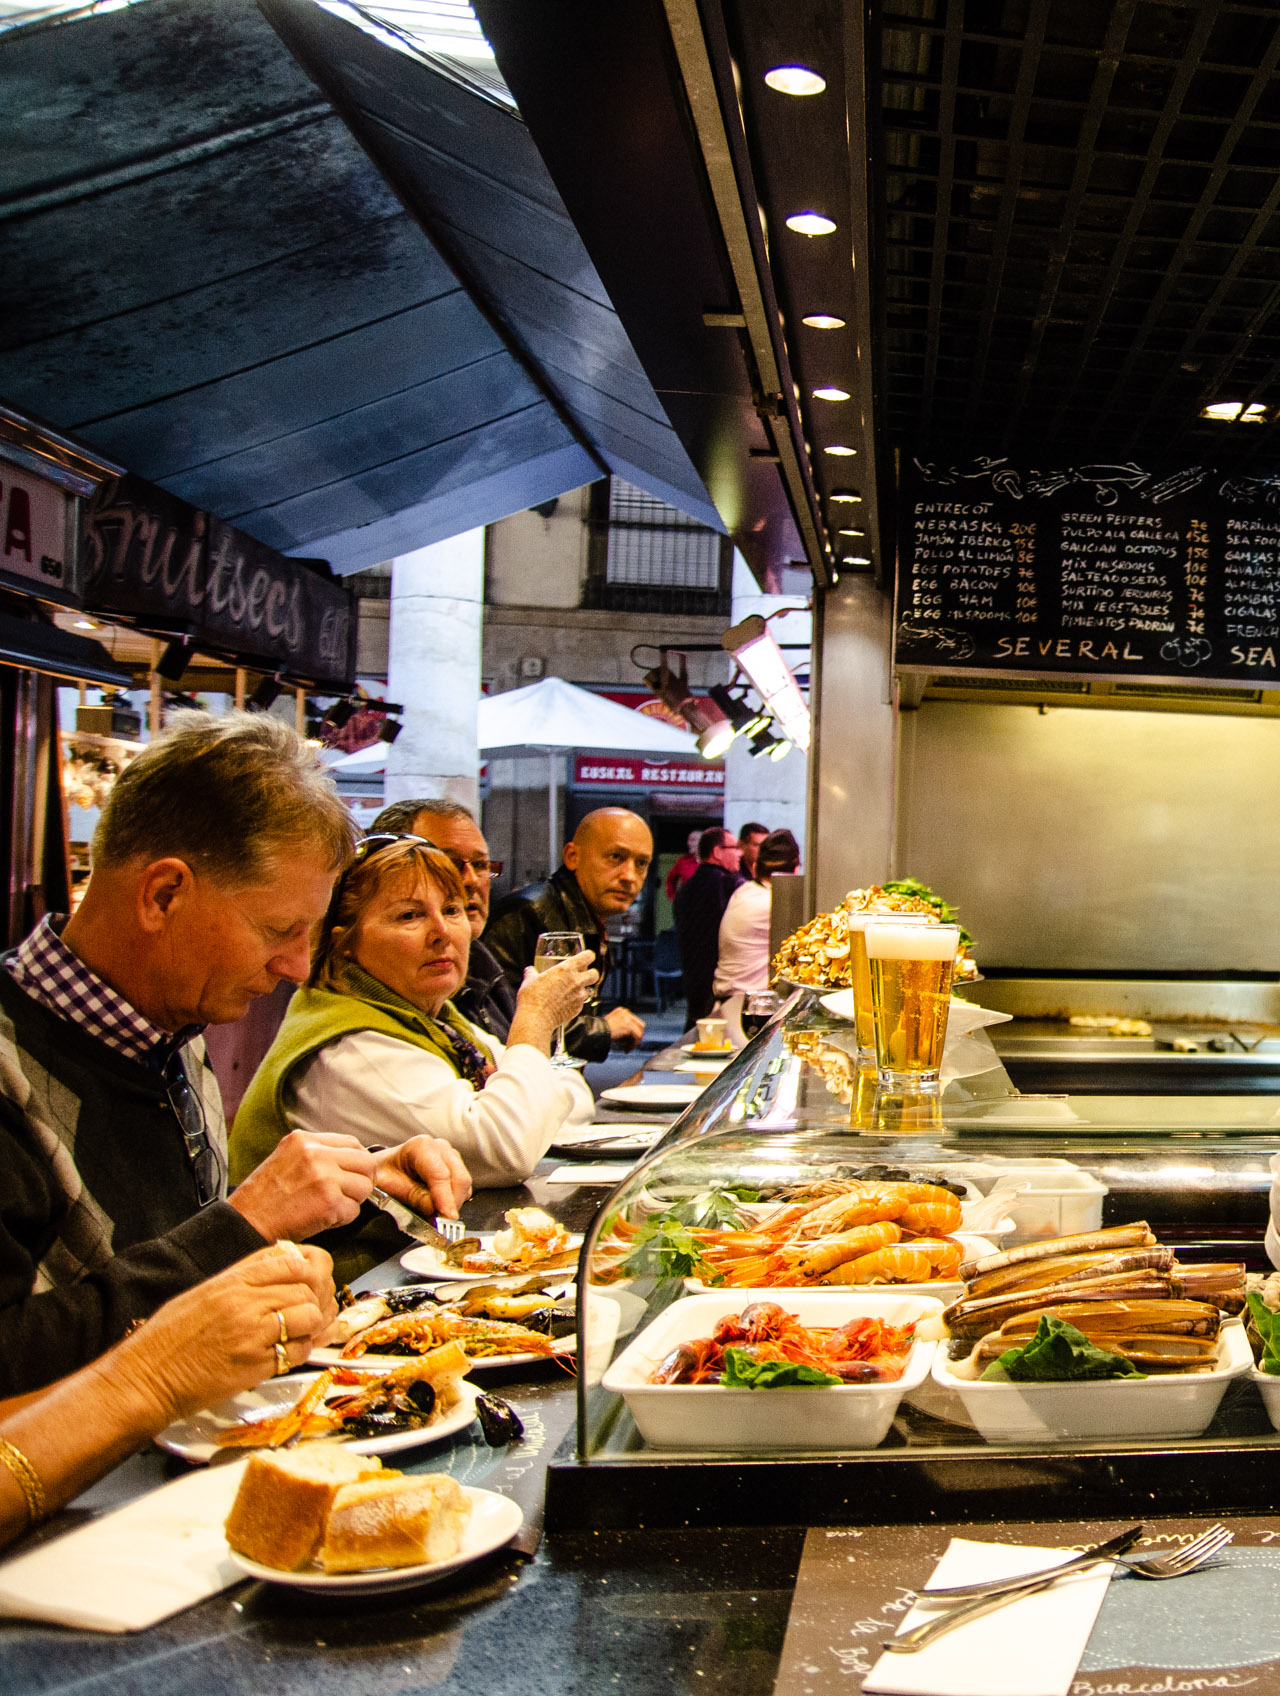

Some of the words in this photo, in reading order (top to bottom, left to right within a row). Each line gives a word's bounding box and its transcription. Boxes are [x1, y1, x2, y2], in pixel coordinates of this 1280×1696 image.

[914, 502, 994, 515] ENTRECOT
[0, 480, 32, 562] A
[914, 520, 1002, 534] NEBRASKA
[1008, 523, 1037, 536] 20€
[1061, 513, 1102, 523] GREEN
[1106, 513, 1162, 528] PEPPERS
[1061, 526, 1102, 538] PULPO
[1185, 530, 1210, 543] 15€
[1226, 534, 1250, 545] SEA
[1014, 538, 1036, 549] 15€
[1060, 541, 1117, 554] GALICIAN
[1124, 545, 1178, 559] OCTOPUS
[1186, 546, 1209, 559] 15€
[914, 548, 954, 559] POLLO
[1017, 550, 1036, 563] 8€
[912, 563, 938, 575] EGG
[942, 564, 1012, 579] POTATOES
[1062, 557, 1087, 570] MIX
[1184, 560, 1208, 573] 10€
[912, 578, 938, 590] EGG
[950, 578, 999, 590] BACON
[1016, 582, 1037, 593] 10€
[1130, 575, 1167, 587] SETAS
[1184, 574, 1208, 586] 10€
[912, 593, 942, 605] EGG
[959, 593, 994, 608] HAM
[1016, 597, 1039, 608] 10€
[1062, 600, 1084, 611] MIX
[913, 608, 941, 619] EGG
[1015, 611, 1039, 623] 10€
[1224, 607, 1277, 621] CIGALAS
[1226, 624, 1279, 639] FRENCH
[992, 637, 1144, 660] SEVERAL
[1230, 645, 1277, 668] SEA
[580, 766, 635, 780] EUSKAL
[641, 767, 725, 783] RESTAURAN
[1072, 1675, 1260, 1696] Barcelona
